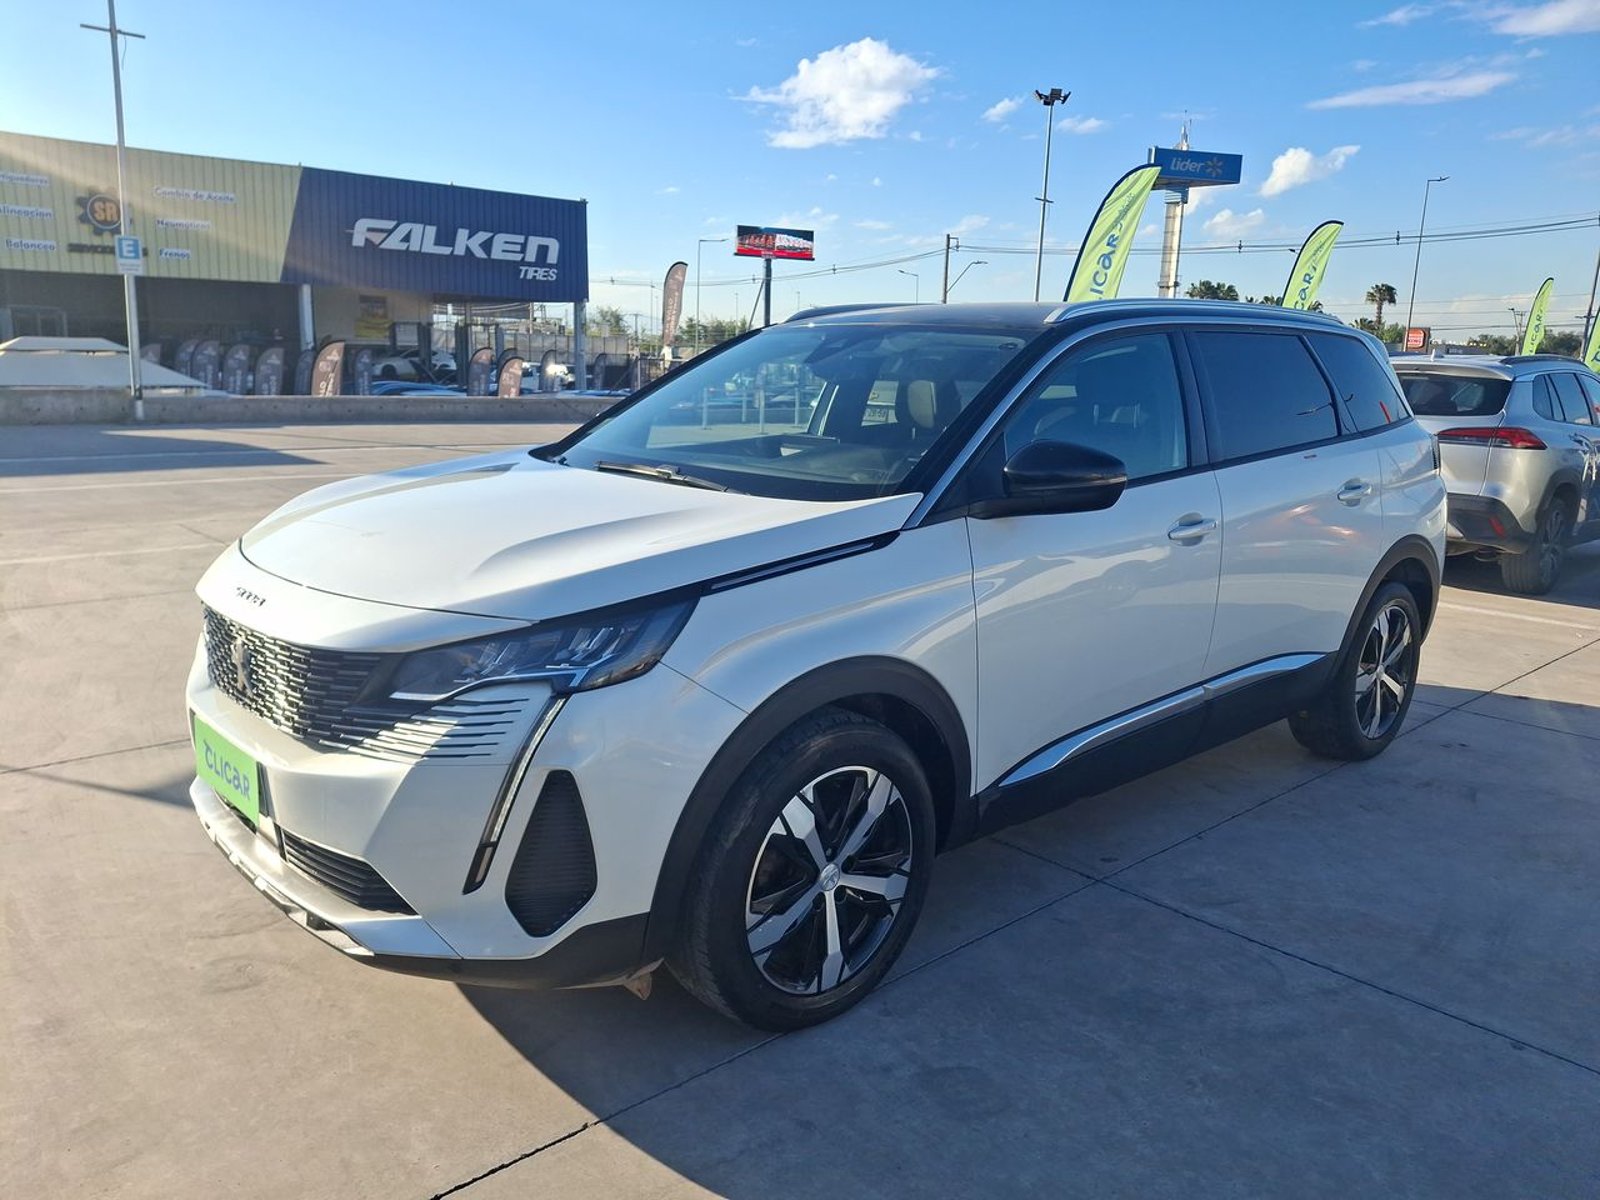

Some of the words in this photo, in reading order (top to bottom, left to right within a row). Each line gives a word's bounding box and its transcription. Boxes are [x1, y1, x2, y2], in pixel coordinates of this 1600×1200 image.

[122, 240, 136, 257] E
[352, 218, 560, 264] FALKEN
[519, 266, 557, 281] TIRES
